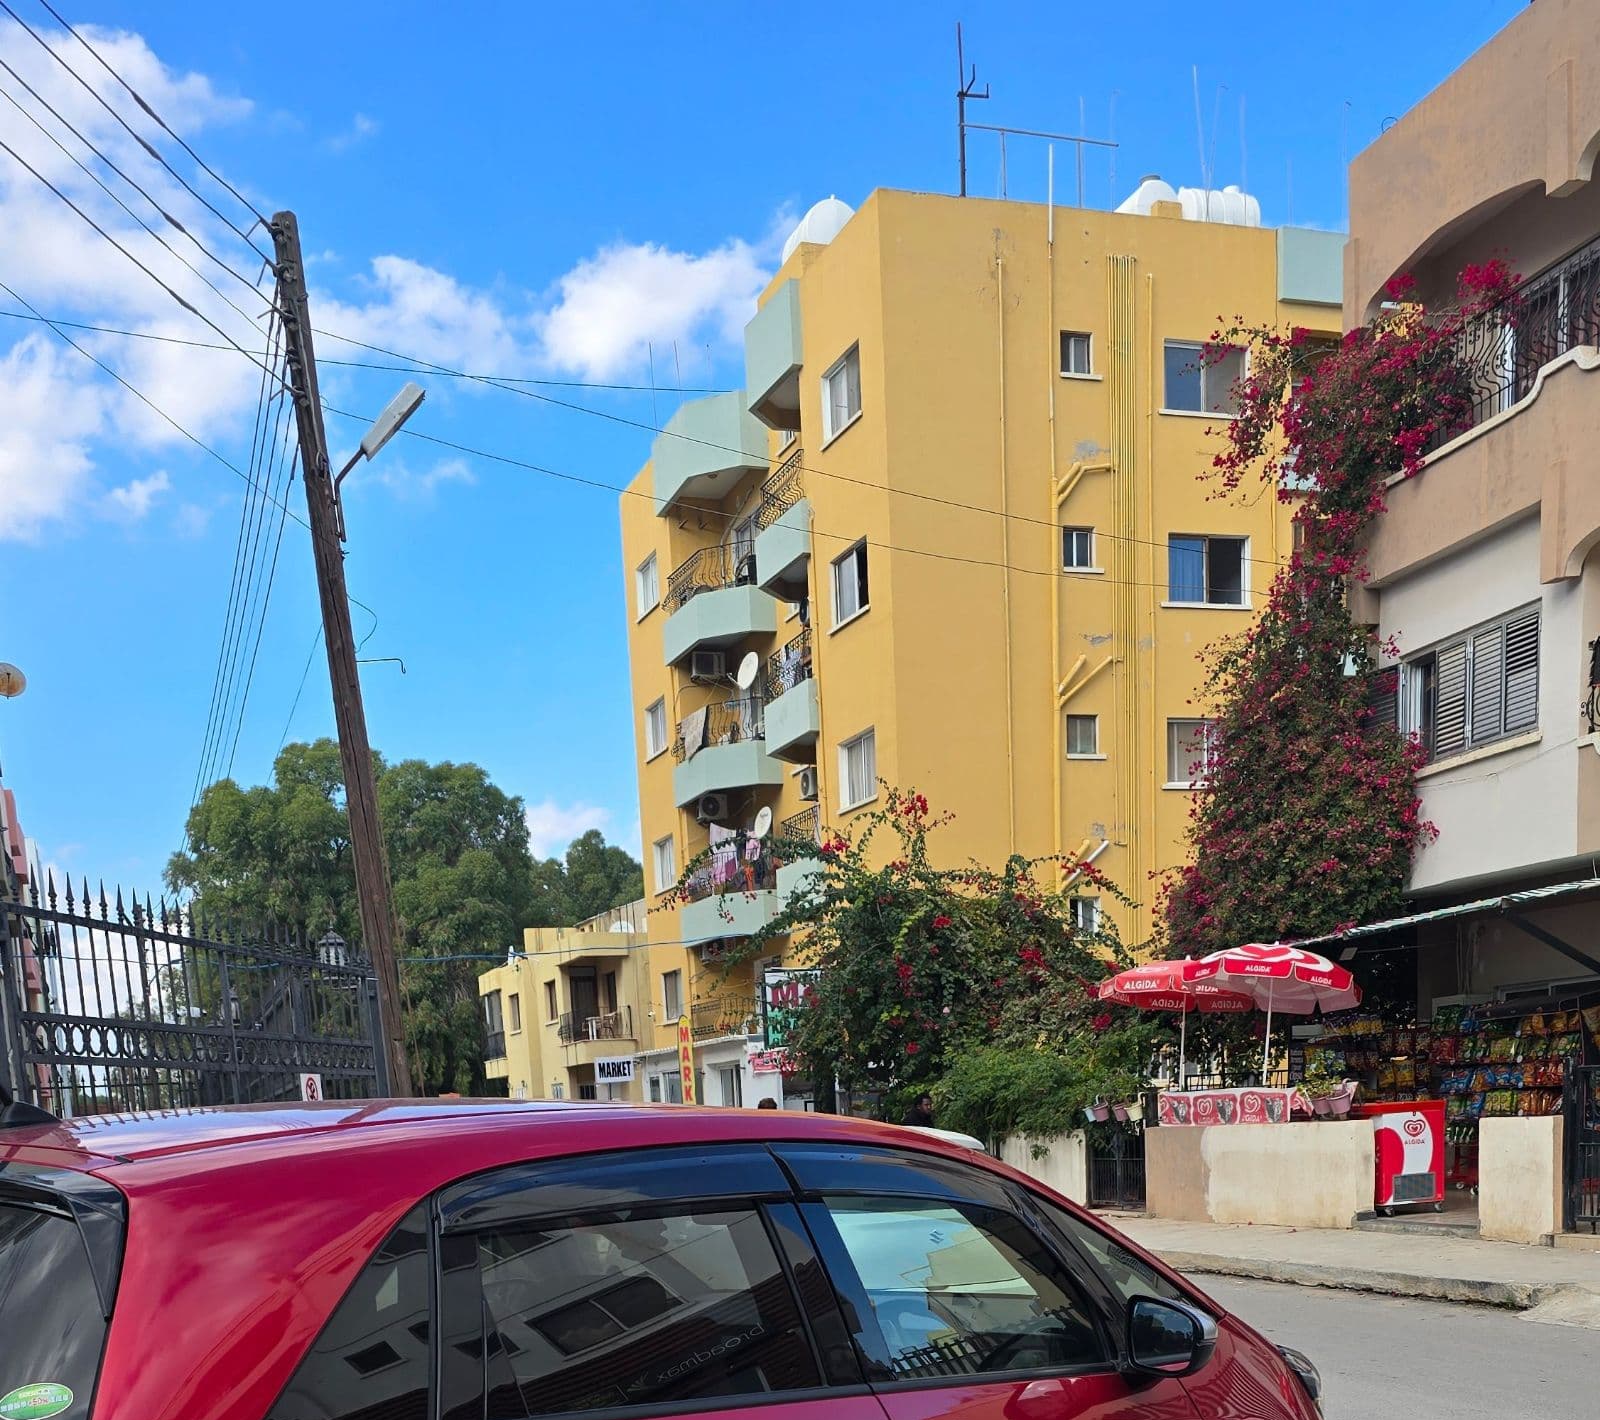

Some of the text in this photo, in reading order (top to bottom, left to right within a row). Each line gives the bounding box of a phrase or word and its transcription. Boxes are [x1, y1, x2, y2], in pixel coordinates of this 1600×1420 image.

[1124, 980, 1158, 990] ALGIDA
[598, 1060, 631, 1078] MARKET
[680, 1026, 693, 1101] MARK
